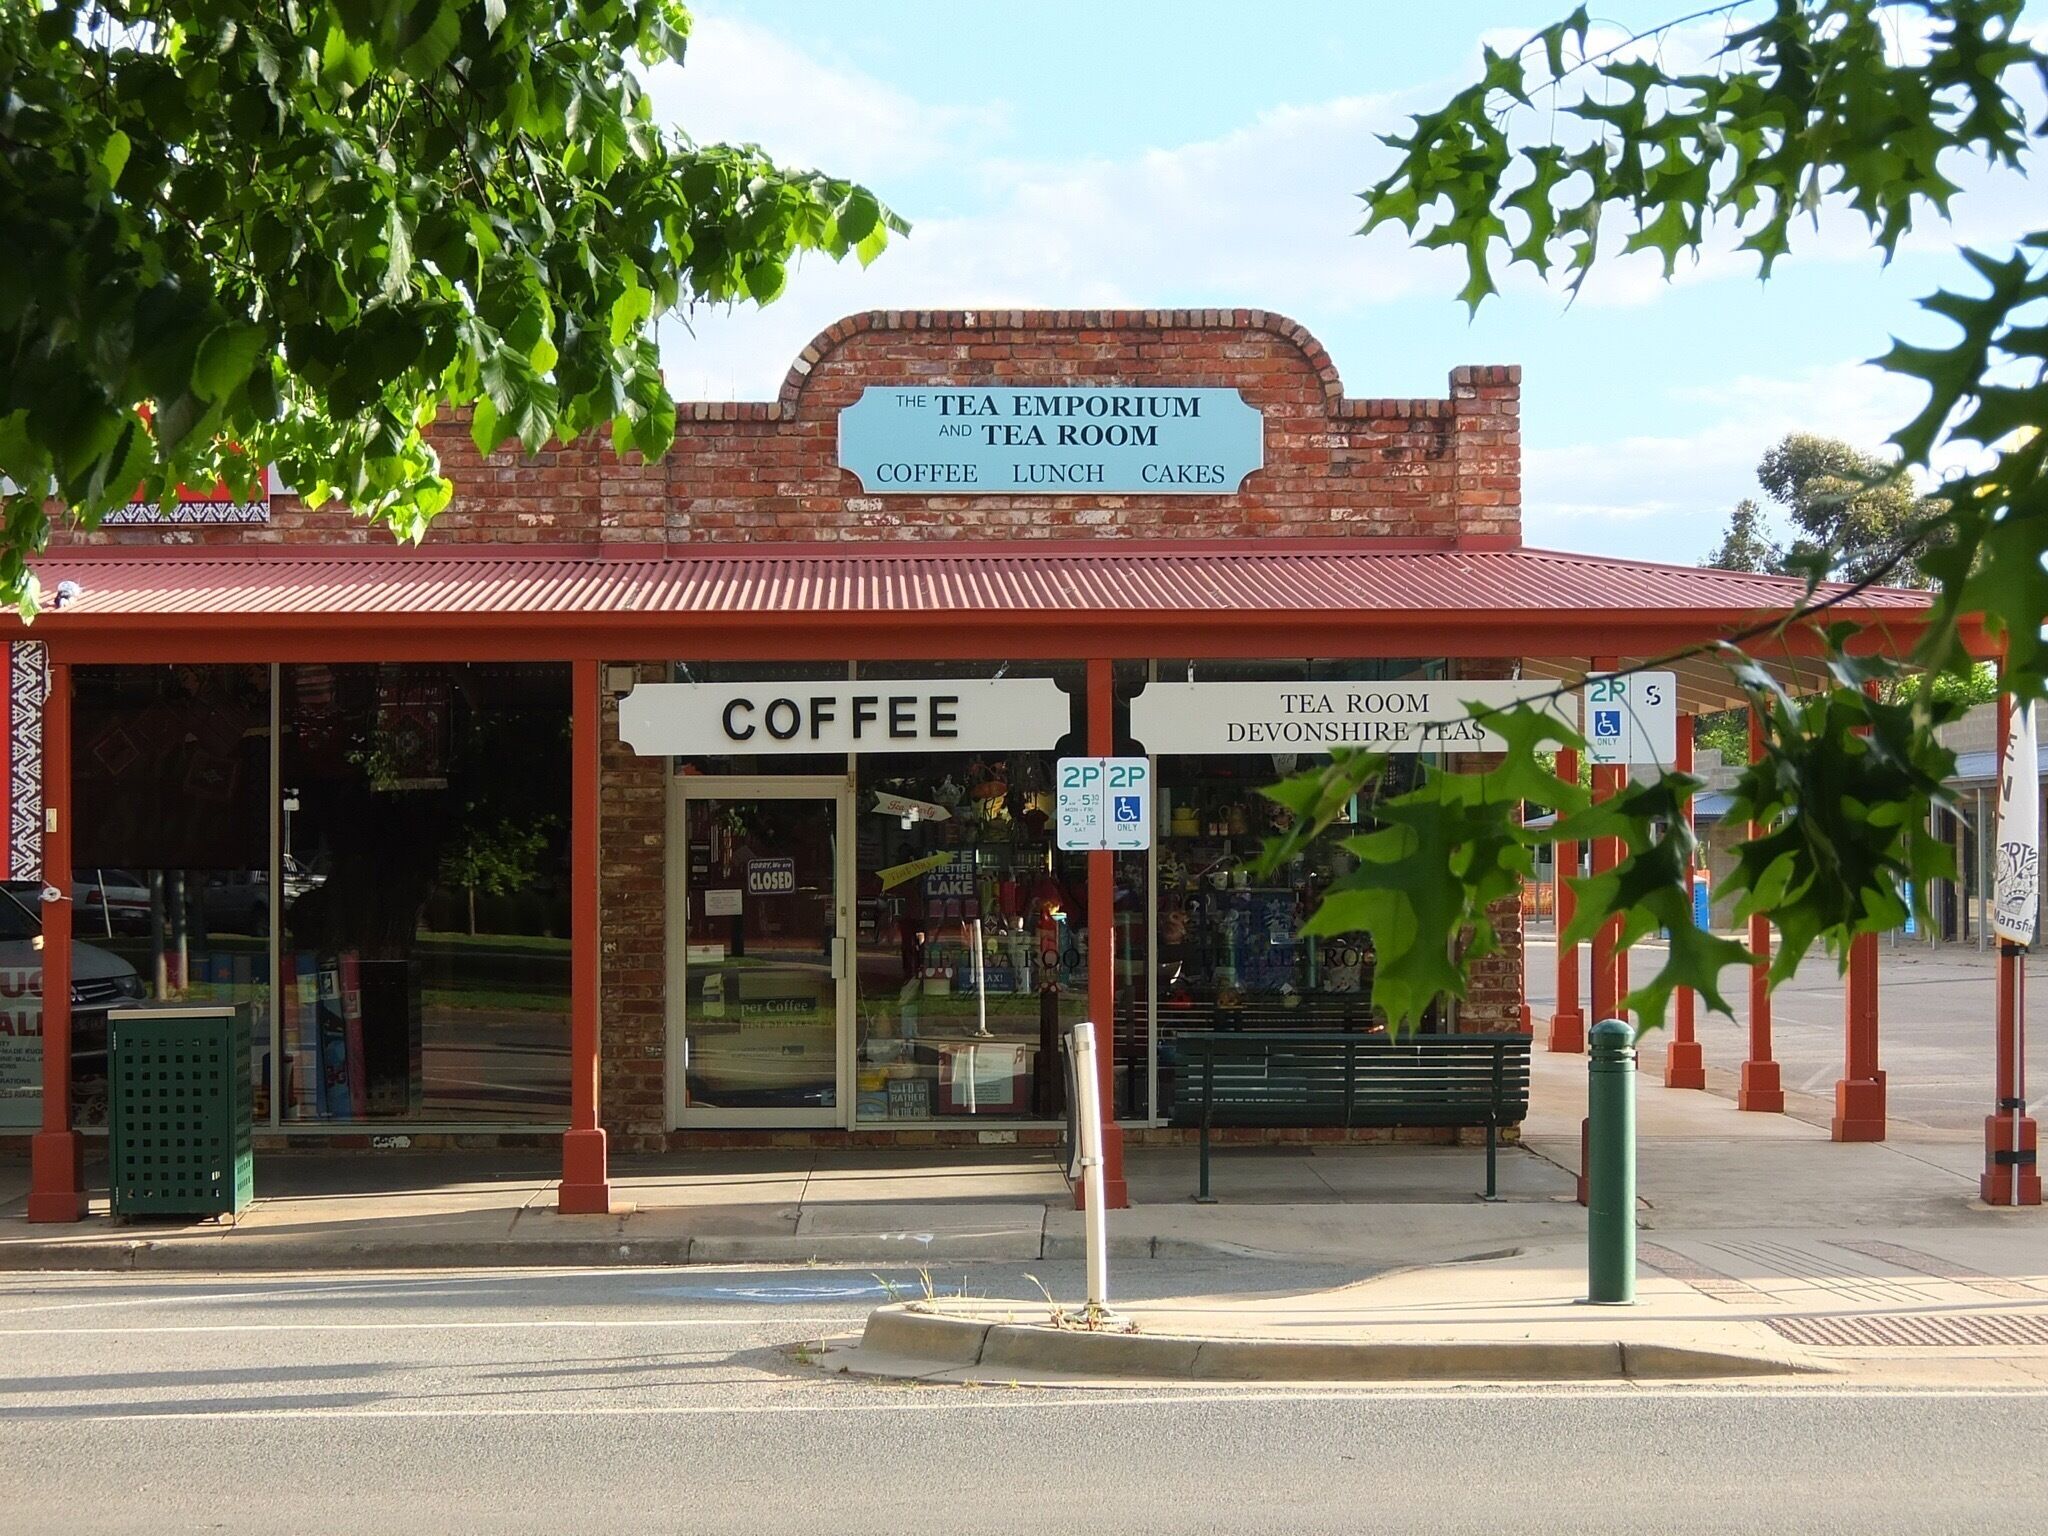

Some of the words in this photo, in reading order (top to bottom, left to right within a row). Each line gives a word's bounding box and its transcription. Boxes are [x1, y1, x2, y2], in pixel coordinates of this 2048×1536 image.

[896, 394, 927, 408] THE
[934, 394, 1000, 417] TEA
[1011, 394, 1201, 418] EMPORIUM
[938, 423, 972, 438] AND
[981, 424, 1048, 446] TEA
[1057, 423, 1159, 447] ROOM
[876, 463, 978, 483] COFFEE
[1012, 463, 1105, 483] LUNCH
[1141, 463, 1226, 484] CAKES
[1280, 693, 1335, 714] TEA
[1346, 693, 1430, 714] ROOM
[722, 695, 959, 741] COFFEE
[1226, 721, 1410, 742] DEVONSHIRE
[1416, 720, 1487, 742] TEAS
[1063, 766, 1100, 788] 2P
[1109, 766, 1146, 788] 2P
[1117, 823, 1138, 832] ONLY
[750, 871, 793, 891] CLOSED
[927, 880, 974, 896] LAKE
[765, 1000, 809, 1012] Coffee
